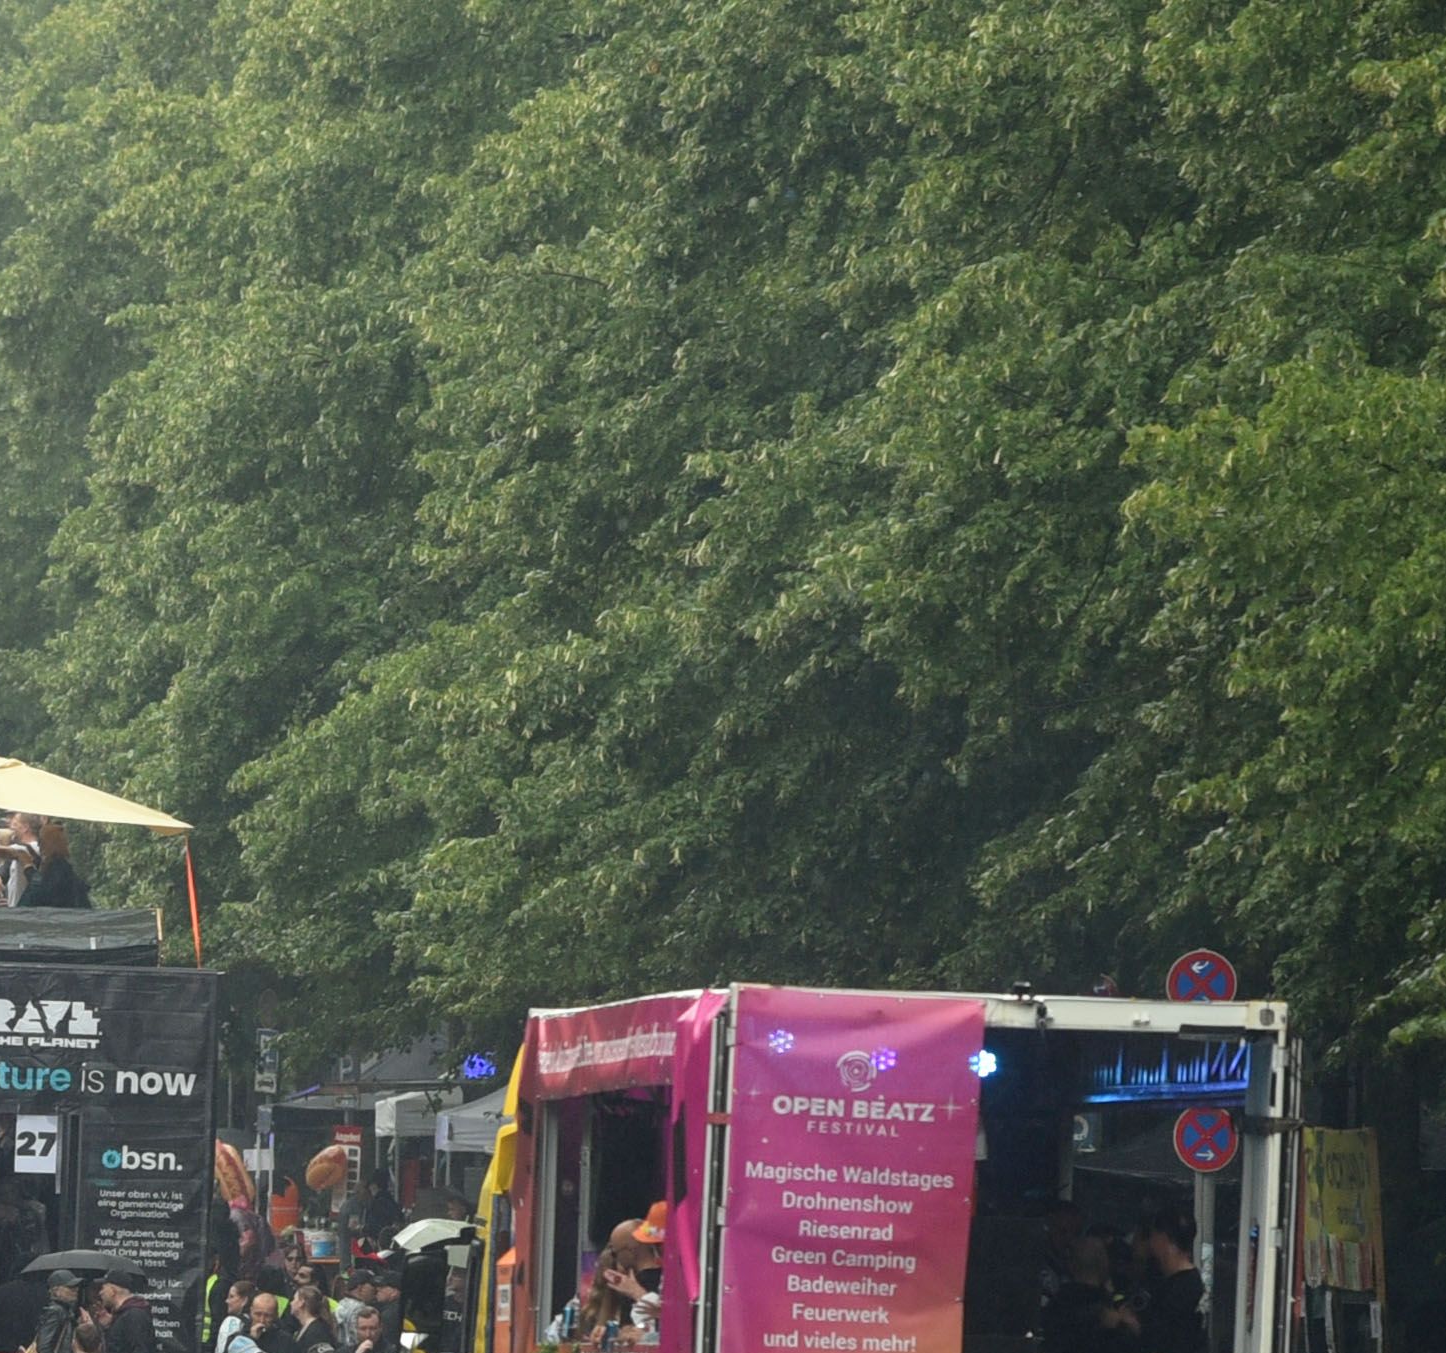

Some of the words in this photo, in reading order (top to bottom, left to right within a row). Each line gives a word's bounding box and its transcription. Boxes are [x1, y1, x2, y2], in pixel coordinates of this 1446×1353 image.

[28, 1036, 100, 1049] PLANET
[81, 1062, 105, 1093] is
[116, 1070, 197, 1096] now
[772, 1095, 845, 1118] OPEN
[852, 1098, 936, 1122] BEATZ
[807, 1121, 899, 1138] FESTIVAL
[16, 1131, 57, 1157] 27
[102, 1147, 183, 1171] obsn.
[745, 1161, 838, 1183] Magische
[842, 1165, 954, 1190] Waldstages
[99, 1189, 126, 1198] Unser
[127, 1190, 151, 1199] obsn
[782, 1191, 914, 1215] Drohnenshow
[99, 1228, 115, 1237] Wir
[157, 1230, 180, 1239] dass
[798, 1220, 894, 1241] Riesenrad
[122, 1239, 140, 1247] uns
[140, 1239, 184, 1249] verbindet
[771, 1246, 827, 1266] Green
[831, 1249, 917, 1273] Camping
[786, 1275, 897, 1297] Badeweiher
[792, 1303, 889, 1325] Feuerwerk
[763, 1330, 799, 1351] und
[804, 1332, 858, 1351] vieles
[863, 1335, 917, 1353] mehr!
